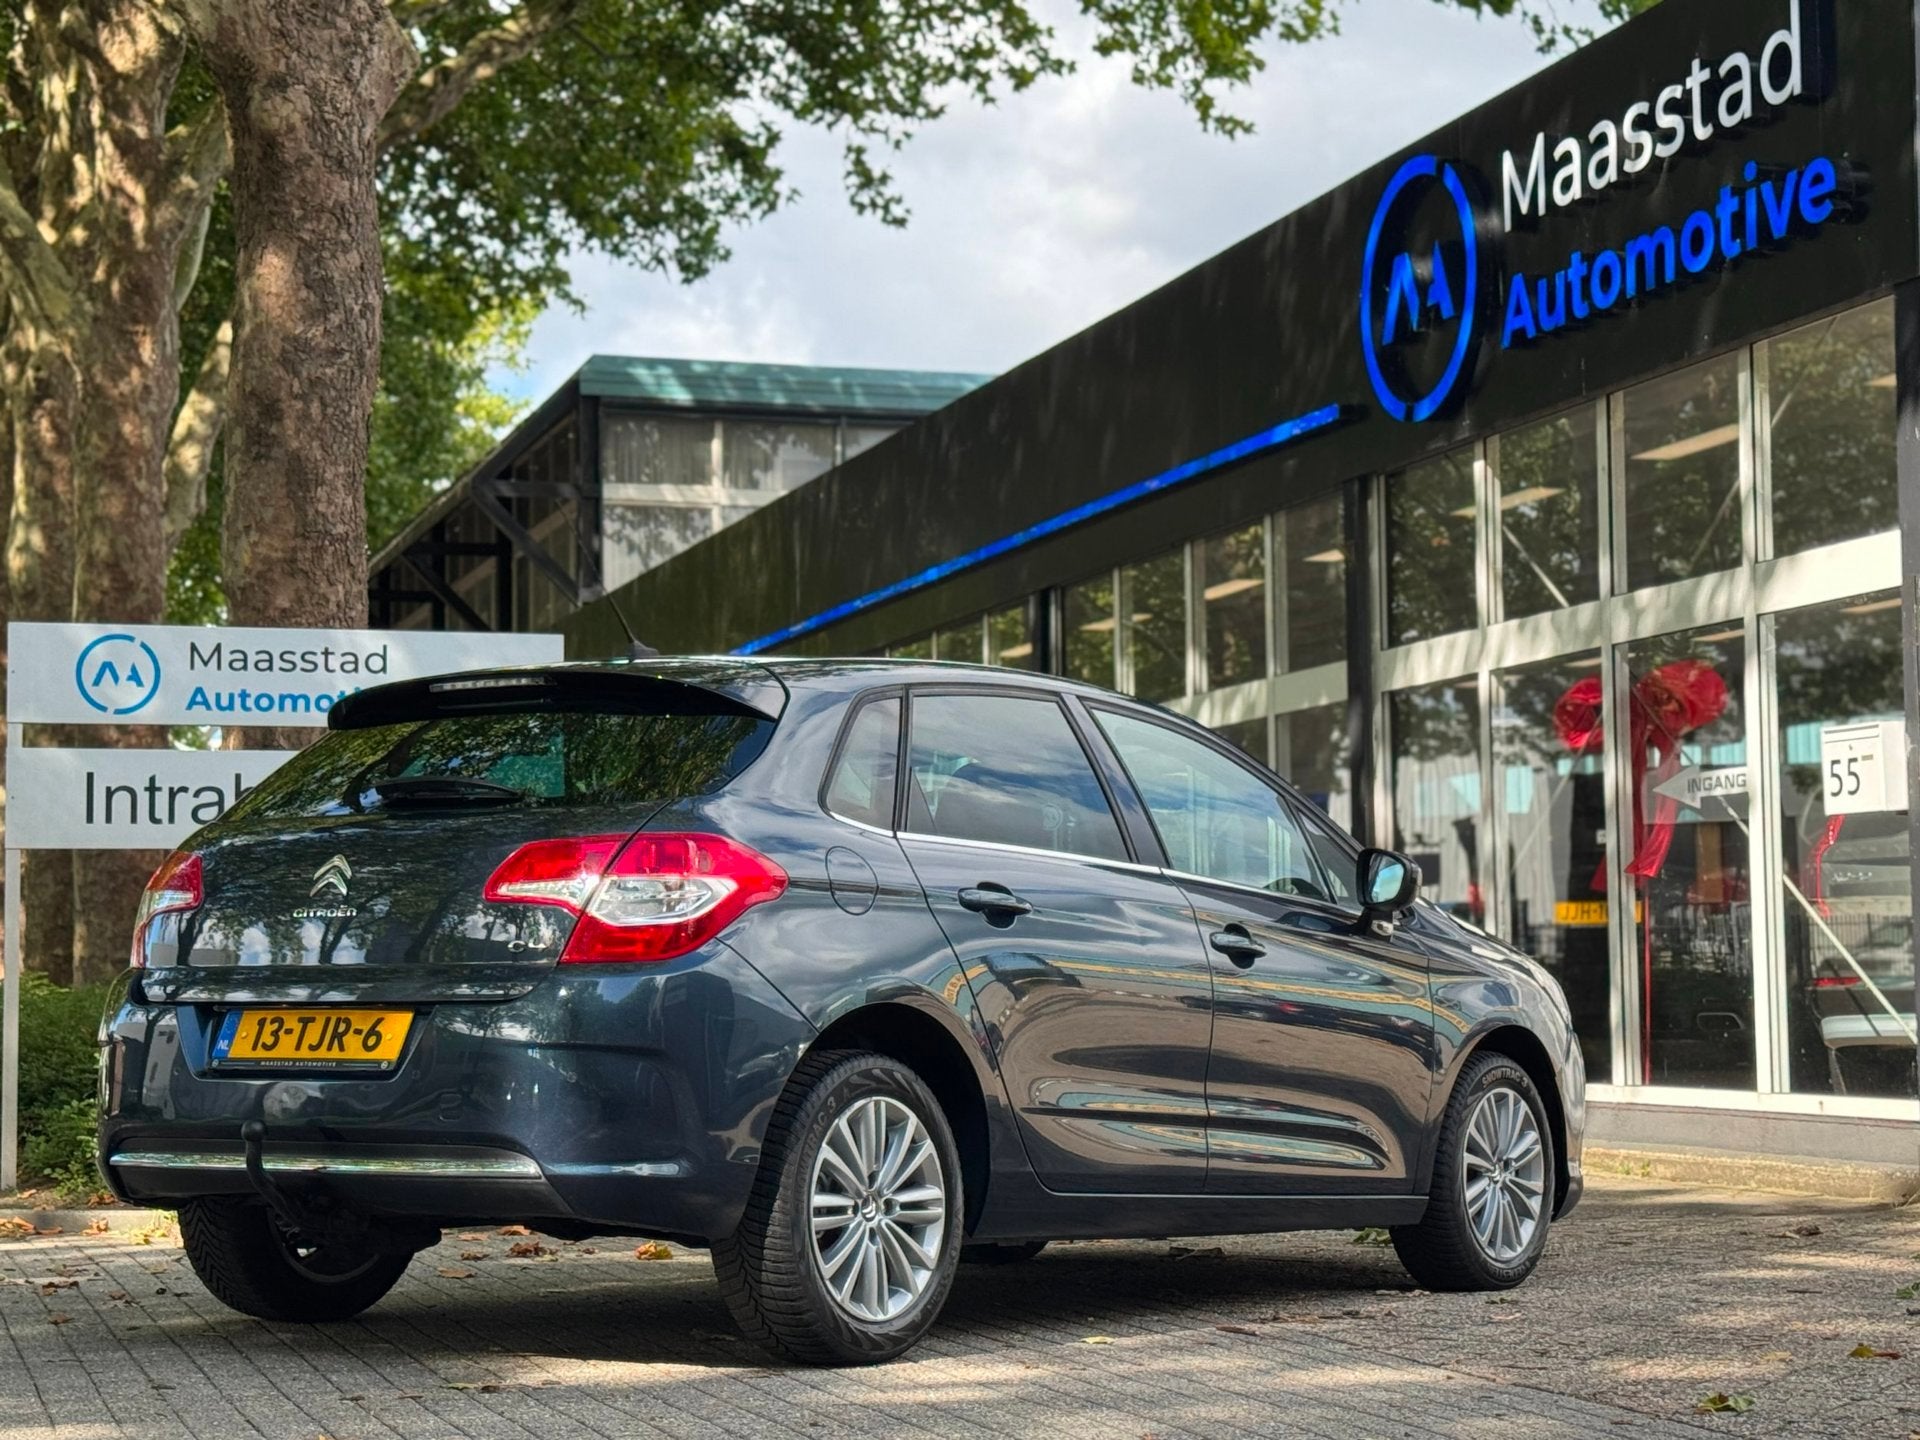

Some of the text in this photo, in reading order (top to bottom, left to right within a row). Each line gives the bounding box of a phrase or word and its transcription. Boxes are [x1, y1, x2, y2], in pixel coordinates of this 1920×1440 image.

[1502, 0, 1802, 233] Maasstad
[1502, 156, 1837, 350] Automotive
[189, 642, 389, 675] Maasstad
[185, 686, 361, 713] Automo
[1687, 773, 1747, 794] INGANG
[1830, 757, 1861, 798] 55
[251, 1016, 385, 1053] 13-TJR-6
